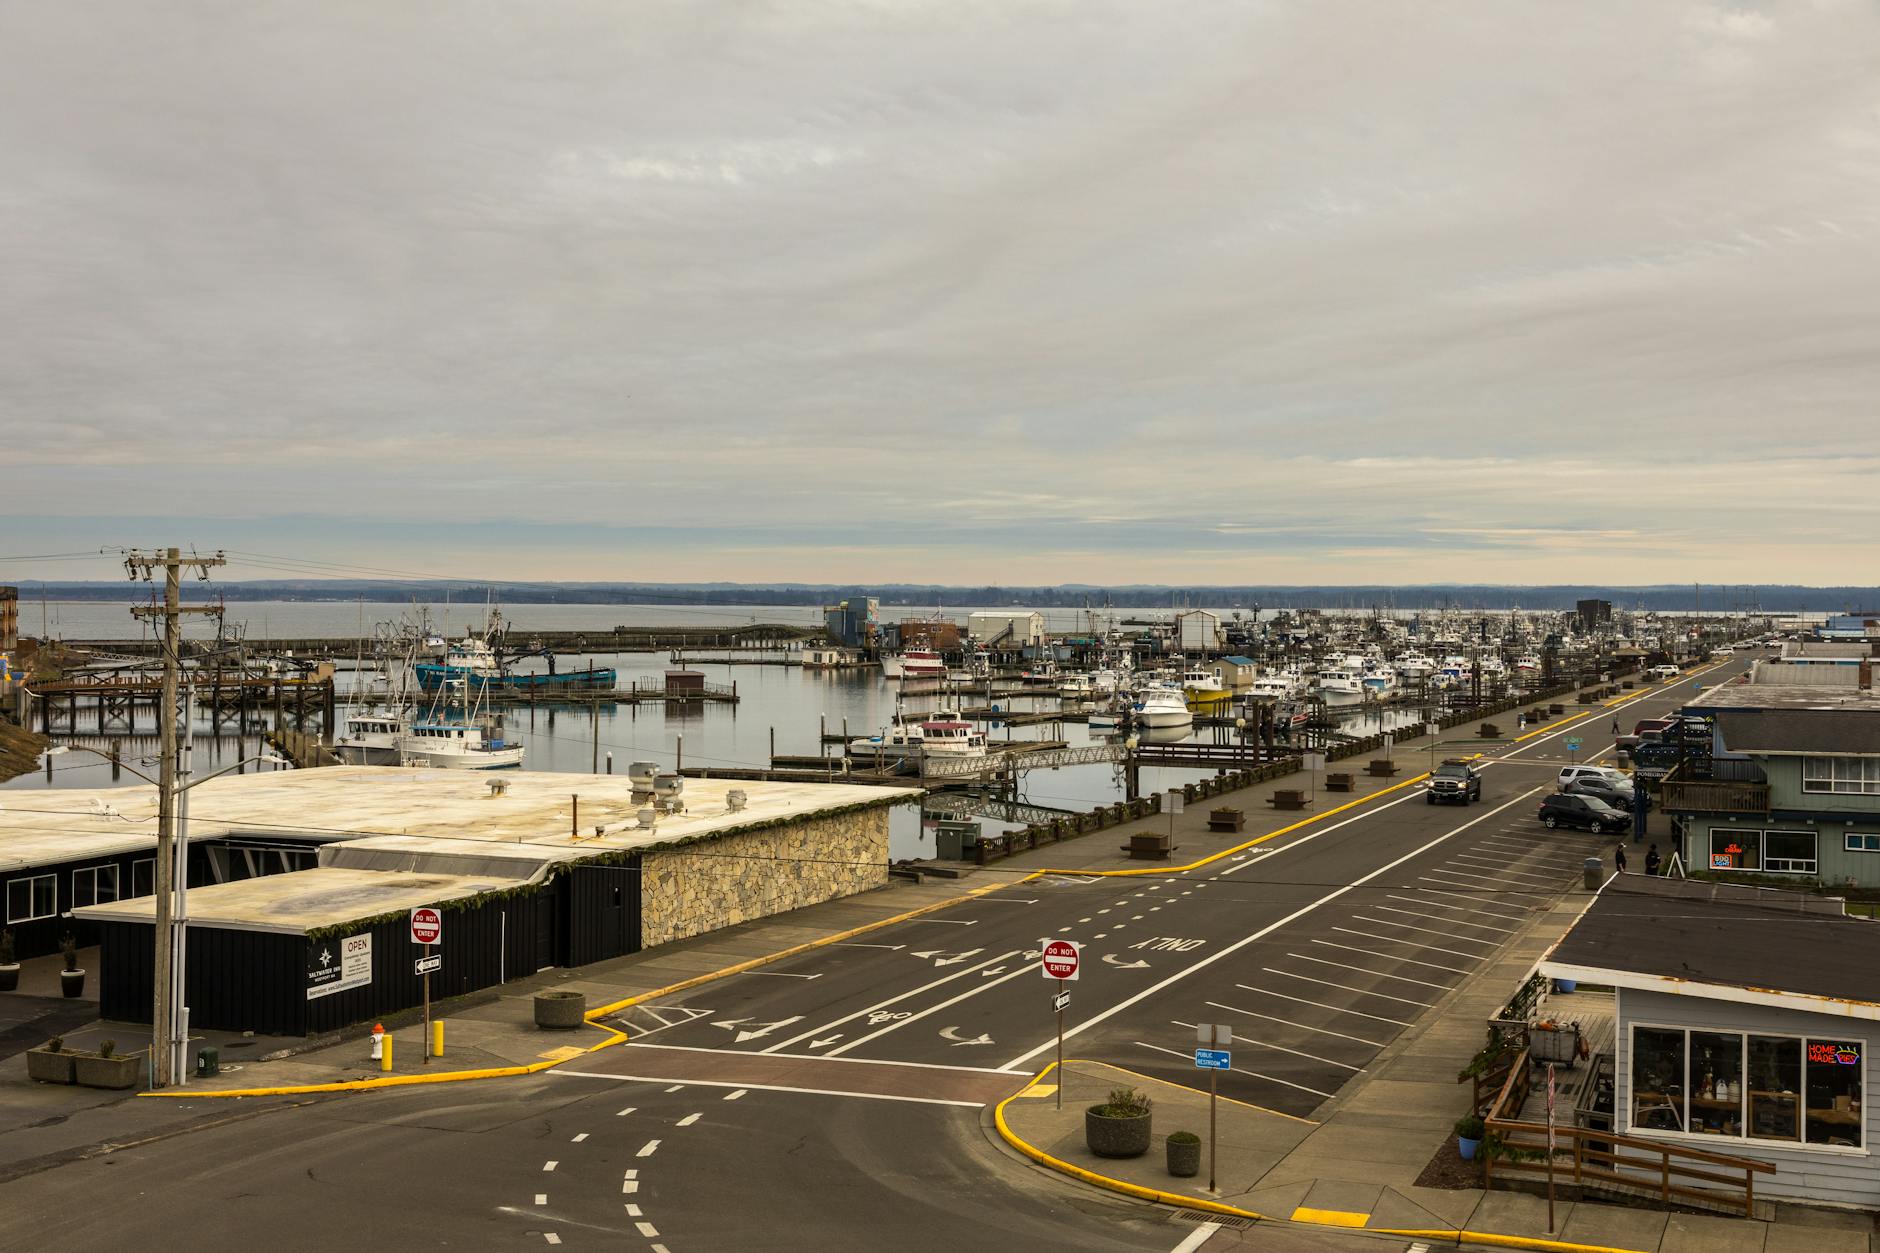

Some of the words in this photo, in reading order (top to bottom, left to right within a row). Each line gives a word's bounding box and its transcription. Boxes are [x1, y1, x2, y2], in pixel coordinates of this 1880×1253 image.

[347, 939, 367, 953] OPEN
[1128, 937, 1206, 952] ONLY
[1048, 947, 1058, 955] DO
[308, 967, 333, 979] SALTWATER
[1050, 964, 1071, 972] ENTER
[1808, 1044, 1836, 1054] HOME
[1197, 1051, 1213, 1059] PUBLIC
[1808, 1053, 1837, 1064] MADE
[1839, 1054, 1855, 1063] PIES
[1197, 1058, 1221, 1067] RESTROOM
